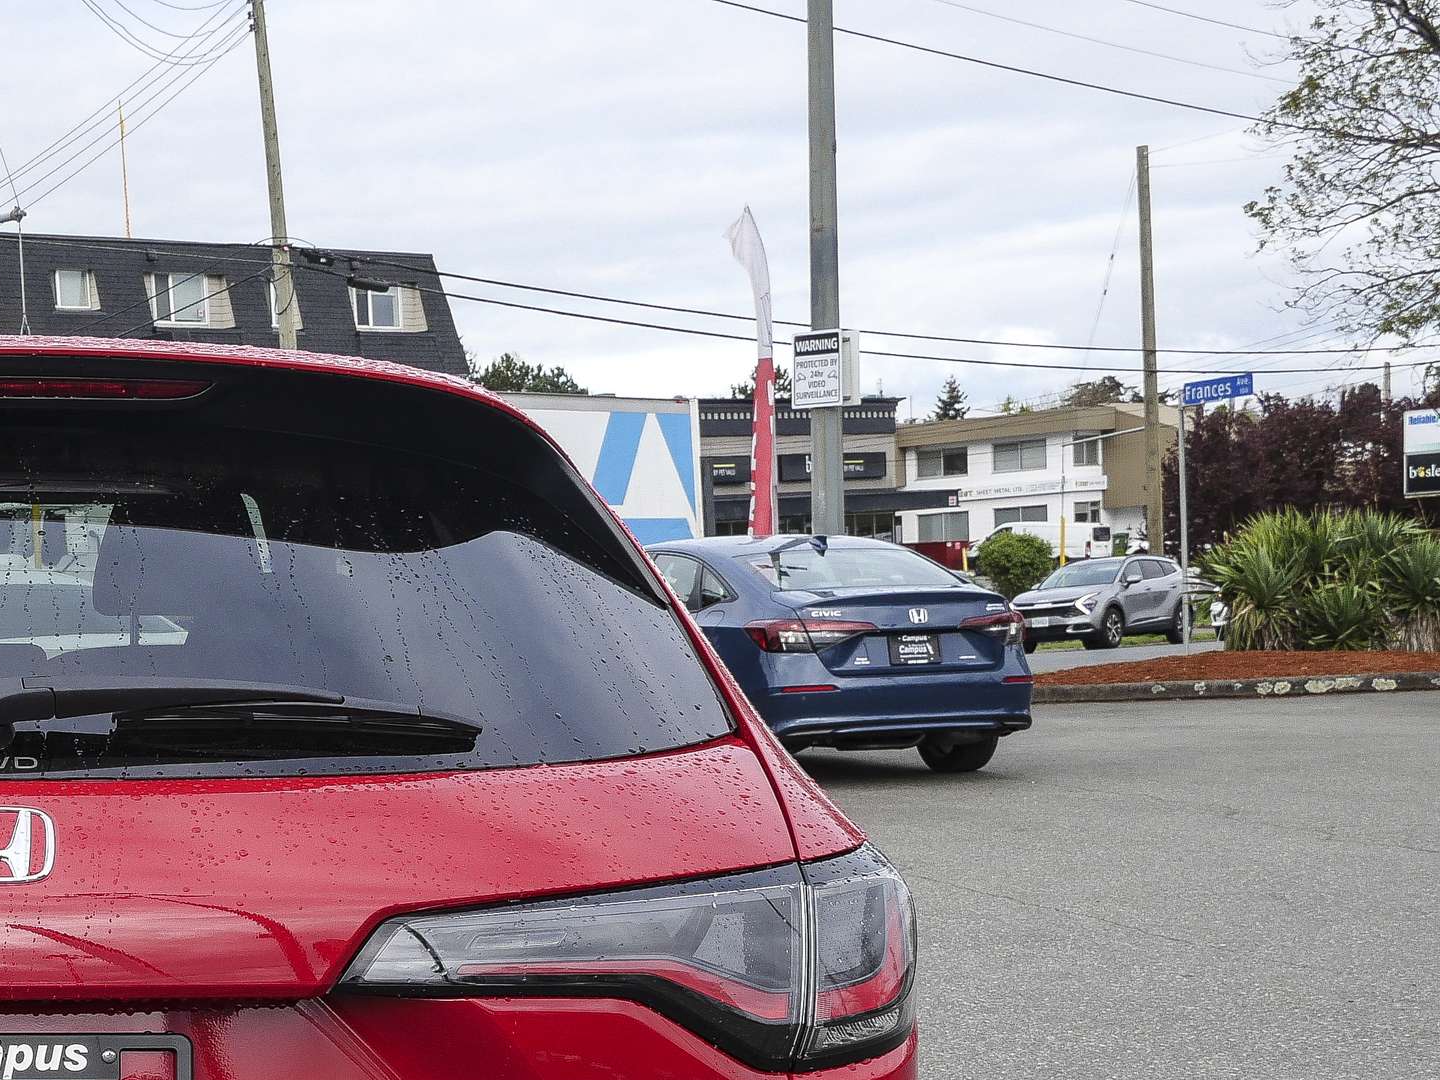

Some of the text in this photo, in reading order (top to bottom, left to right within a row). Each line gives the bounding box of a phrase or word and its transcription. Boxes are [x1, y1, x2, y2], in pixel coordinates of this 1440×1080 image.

[795, 337, 838, 353] WARNING
[796, 358, 838, 369] PROTECTED BY
[807, 380, 826, 389] VIDEO
[795, 388, 838, 401] SURVEILLANCE
[1185, 382, 1232, 401] Frances
[811, 610, 842, 618] CIVIC
